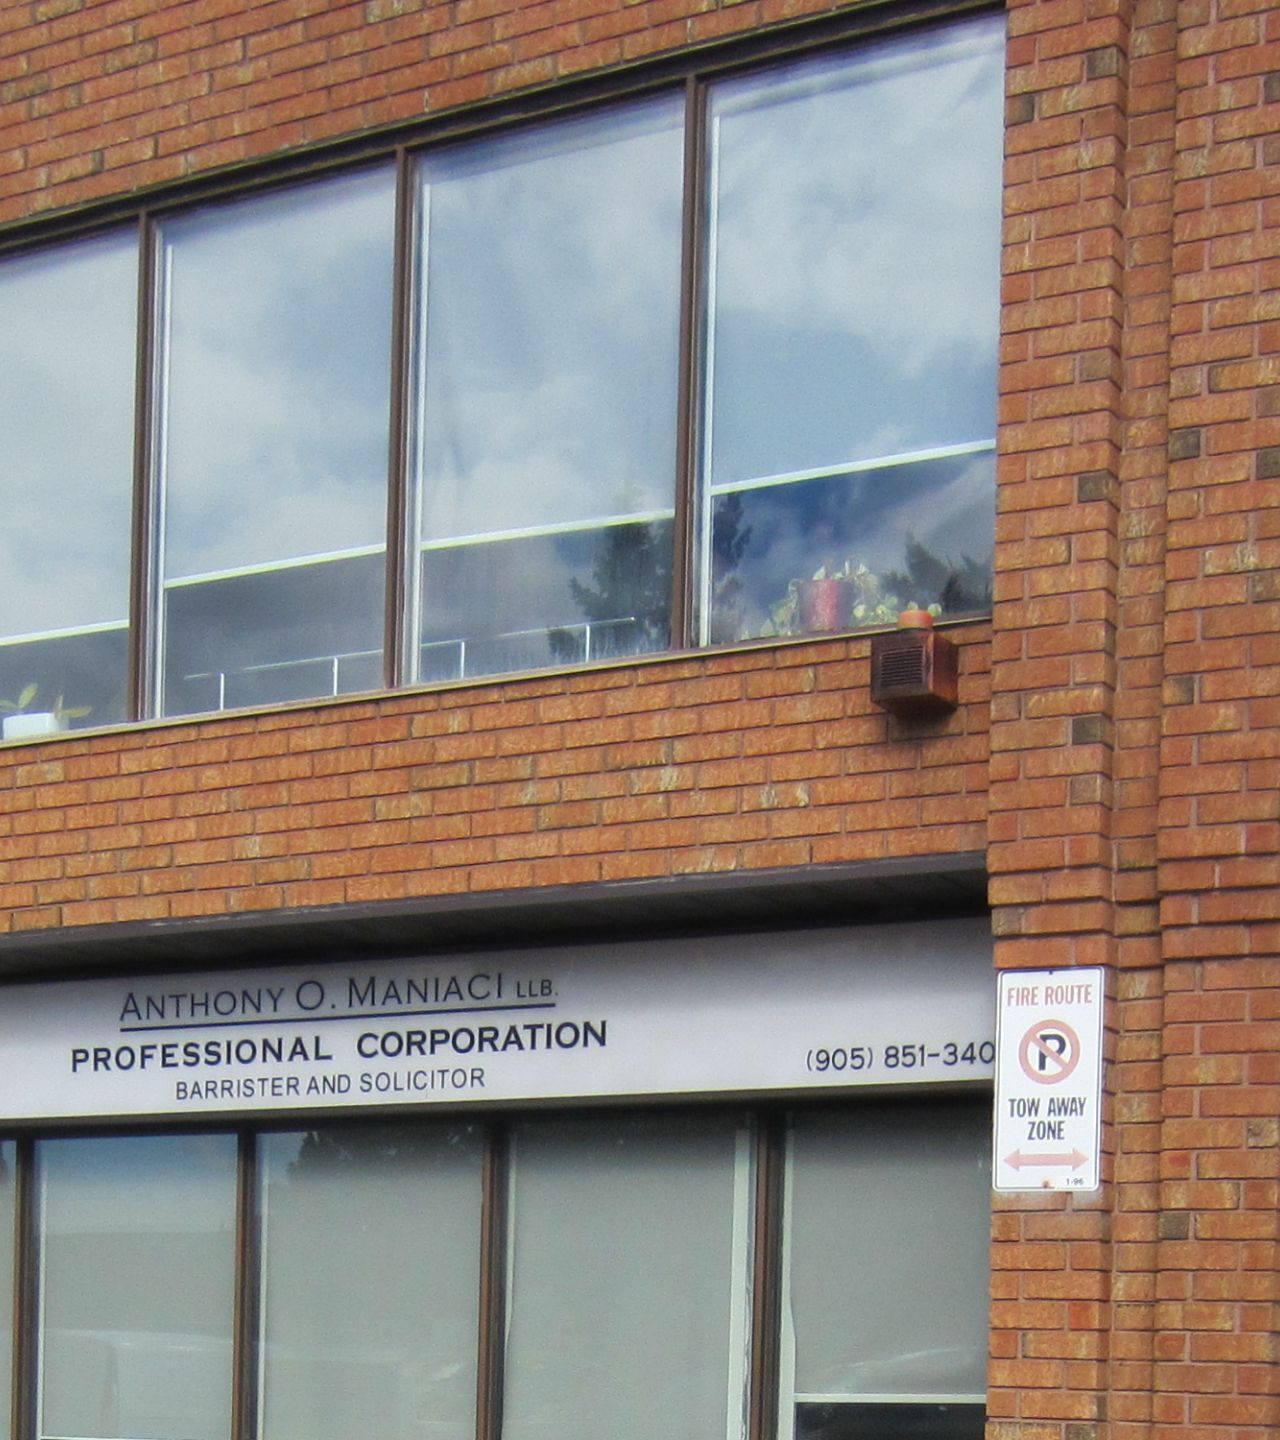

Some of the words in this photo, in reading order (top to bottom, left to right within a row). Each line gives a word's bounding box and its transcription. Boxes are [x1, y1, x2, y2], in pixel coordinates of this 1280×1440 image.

[120, 986, 285, 1022] ANTHONY
[347, 973, 503, 1007] MANIACI
[1007, 985, 1039, 1007] FIRE
[1044, 984, 1093, 1006] ROUTE
[72, 1035, 333, 1072] PROFESSIONAL
[357, 1020, 607, 1058] CORPORATION
[806, 1046, 873, 1071] (905)
[175, 1075, 300, 1100] BARRISTER
[306, 1073, 352, 1095] AND
[359, 1067, 485, 1093] SOLICITOR
[1008, 1098, 1040, 1118] TOW
[1047, 1096, 1087, 1117] AWAY
[1027, 1120, 1065, 1141] ZONE
